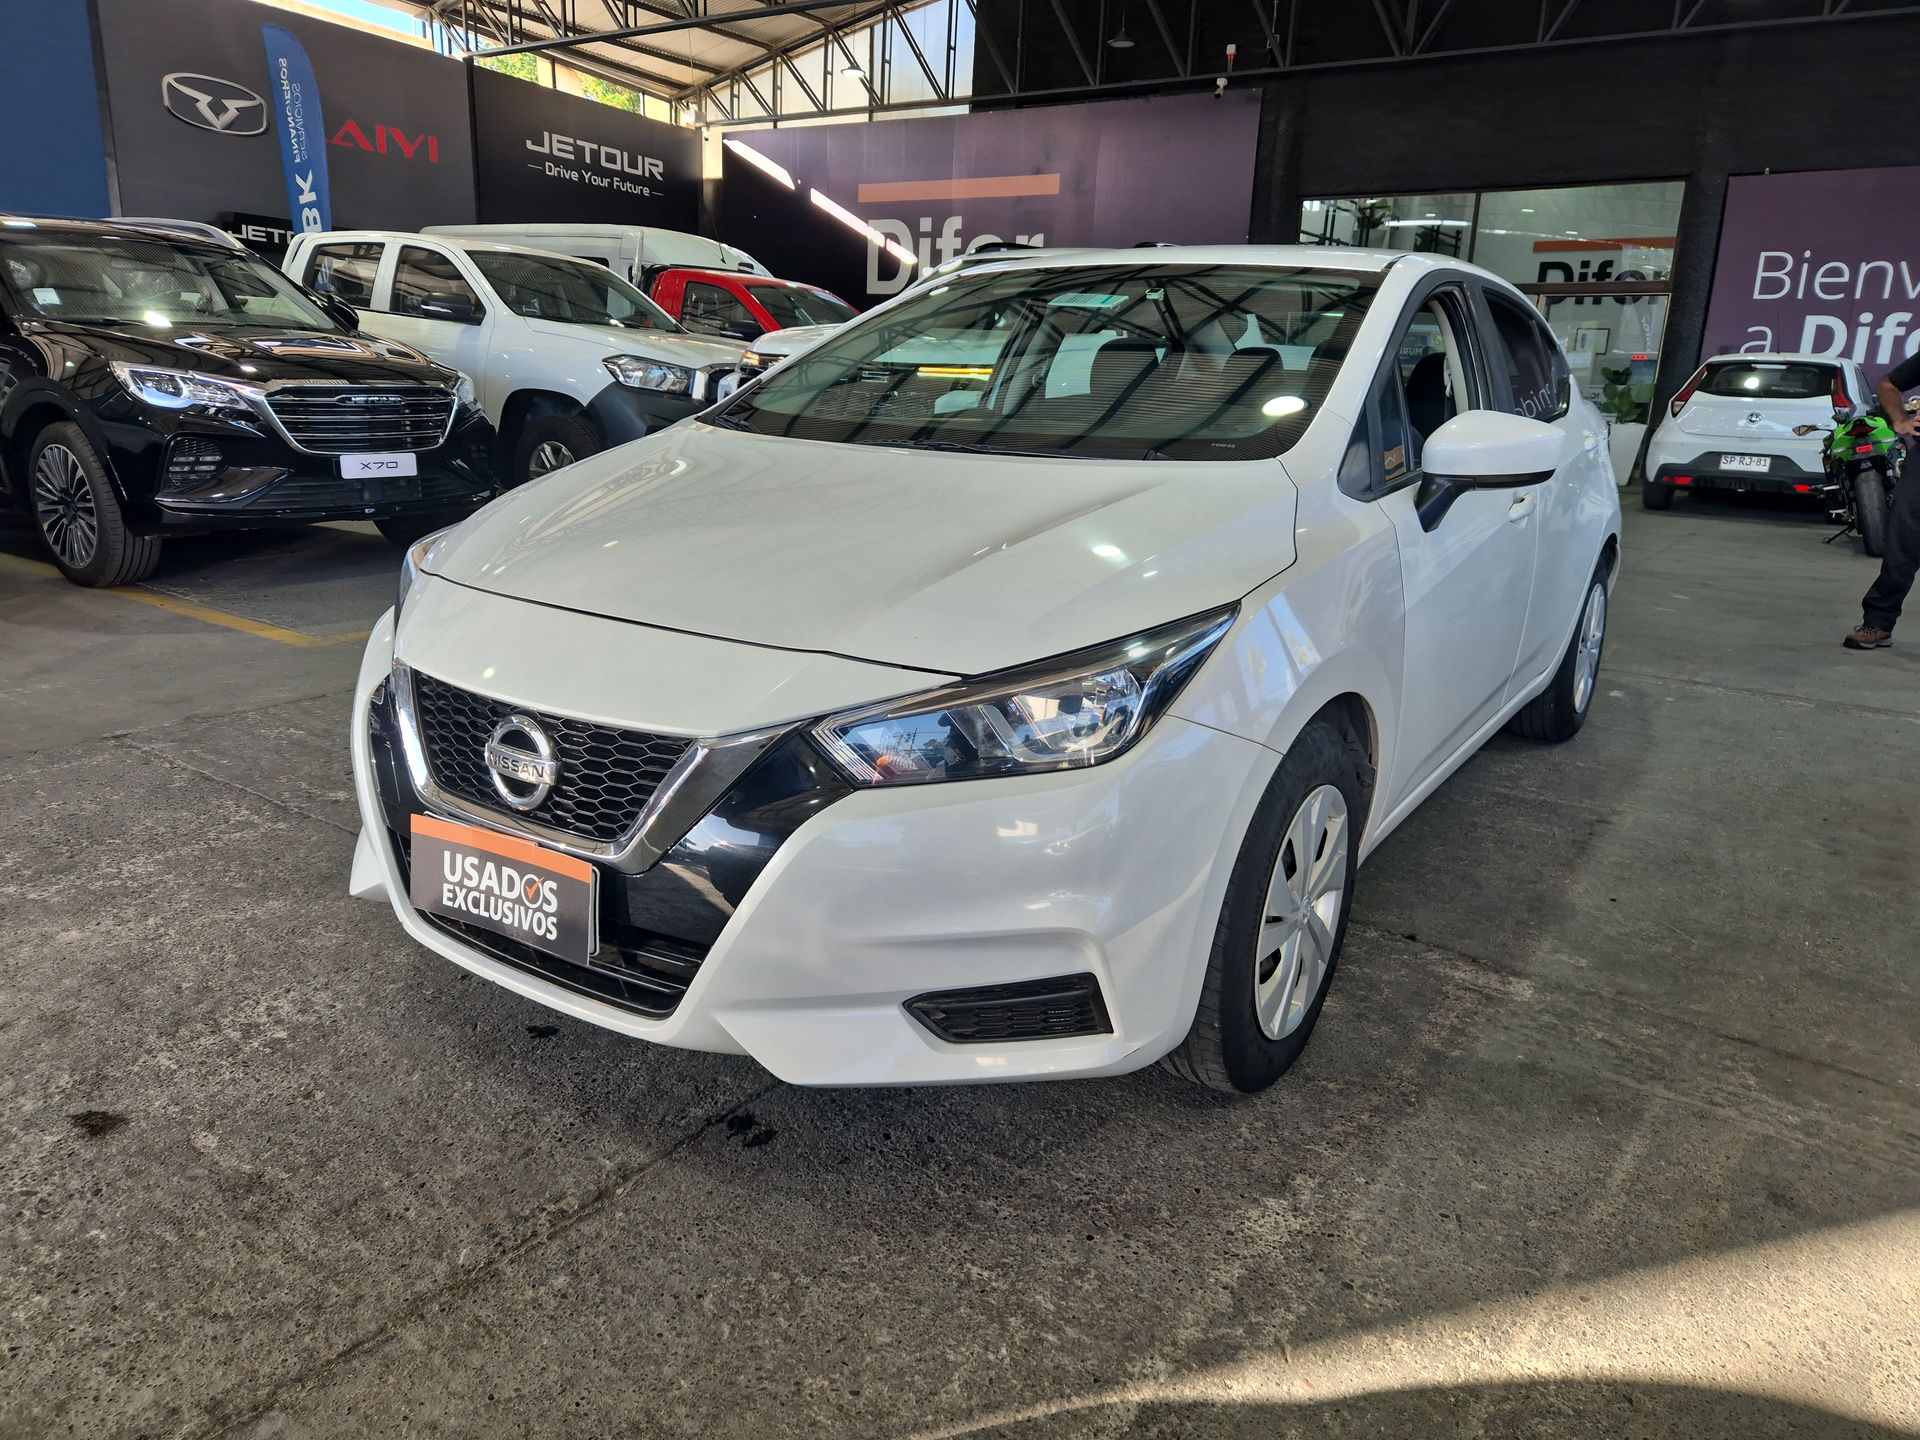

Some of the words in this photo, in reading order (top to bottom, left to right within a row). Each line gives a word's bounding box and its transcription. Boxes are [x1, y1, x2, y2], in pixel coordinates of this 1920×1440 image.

[325, 118, 439, 163] AIYI
[525, 131, 664, 181] JETOUR
[545, 162, 579, 182] Drive
[581, 170, 611, 188] Your
[613, 177, 650, 197] Future
[1739, 326, 1773, 353] a
[488, 754, 545, 779] NISSAN
[443, 850, 558, 914] USADOS
[442, 883, 558, 941] EXCLUSIVOS
